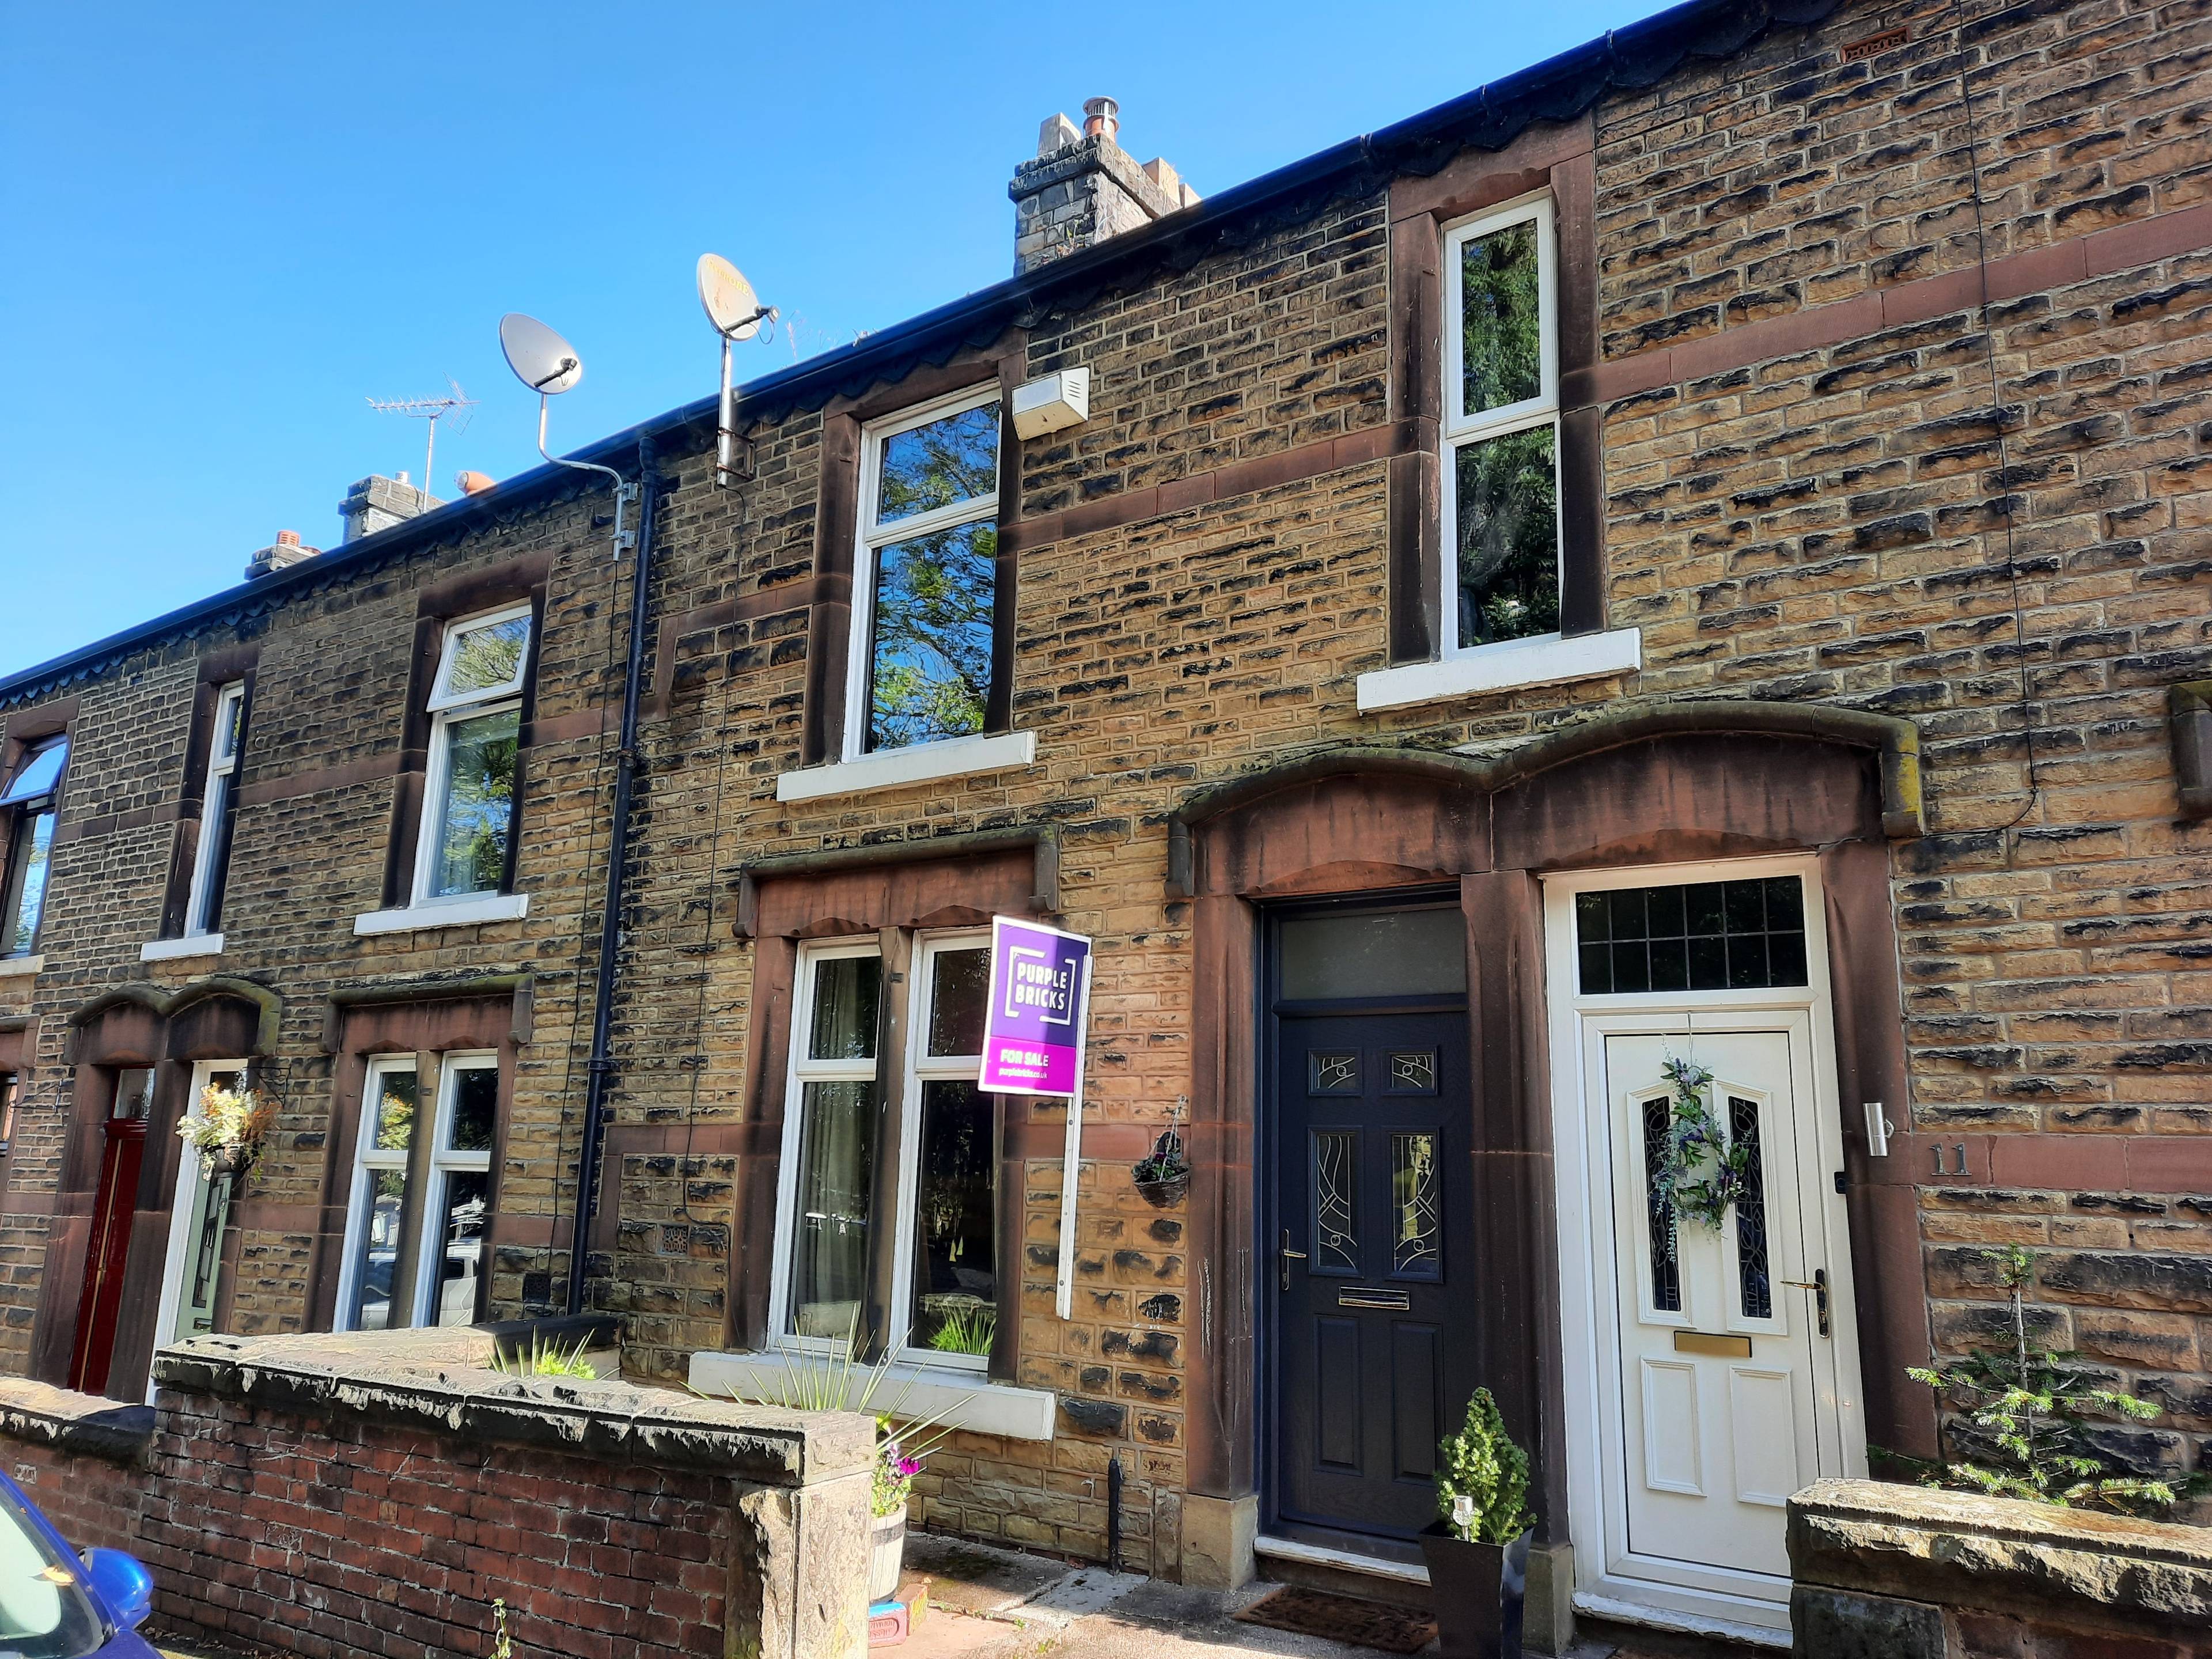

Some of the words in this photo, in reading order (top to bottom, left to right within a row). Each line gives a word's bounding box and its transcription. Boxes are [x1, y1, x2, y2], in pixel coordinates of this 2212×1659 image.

[1017, 961, 1067, 989] PURPLE
[1015, 983, 1065, 1010] BRICKS
[1000, 1049, 1023, 1065] FOR
[1024, 1052, 1049, 1067] SALE
[998, 1067, 1048, 1079] purplebricks.co.uk
[1929, 1142, 1972, 1176] 11
